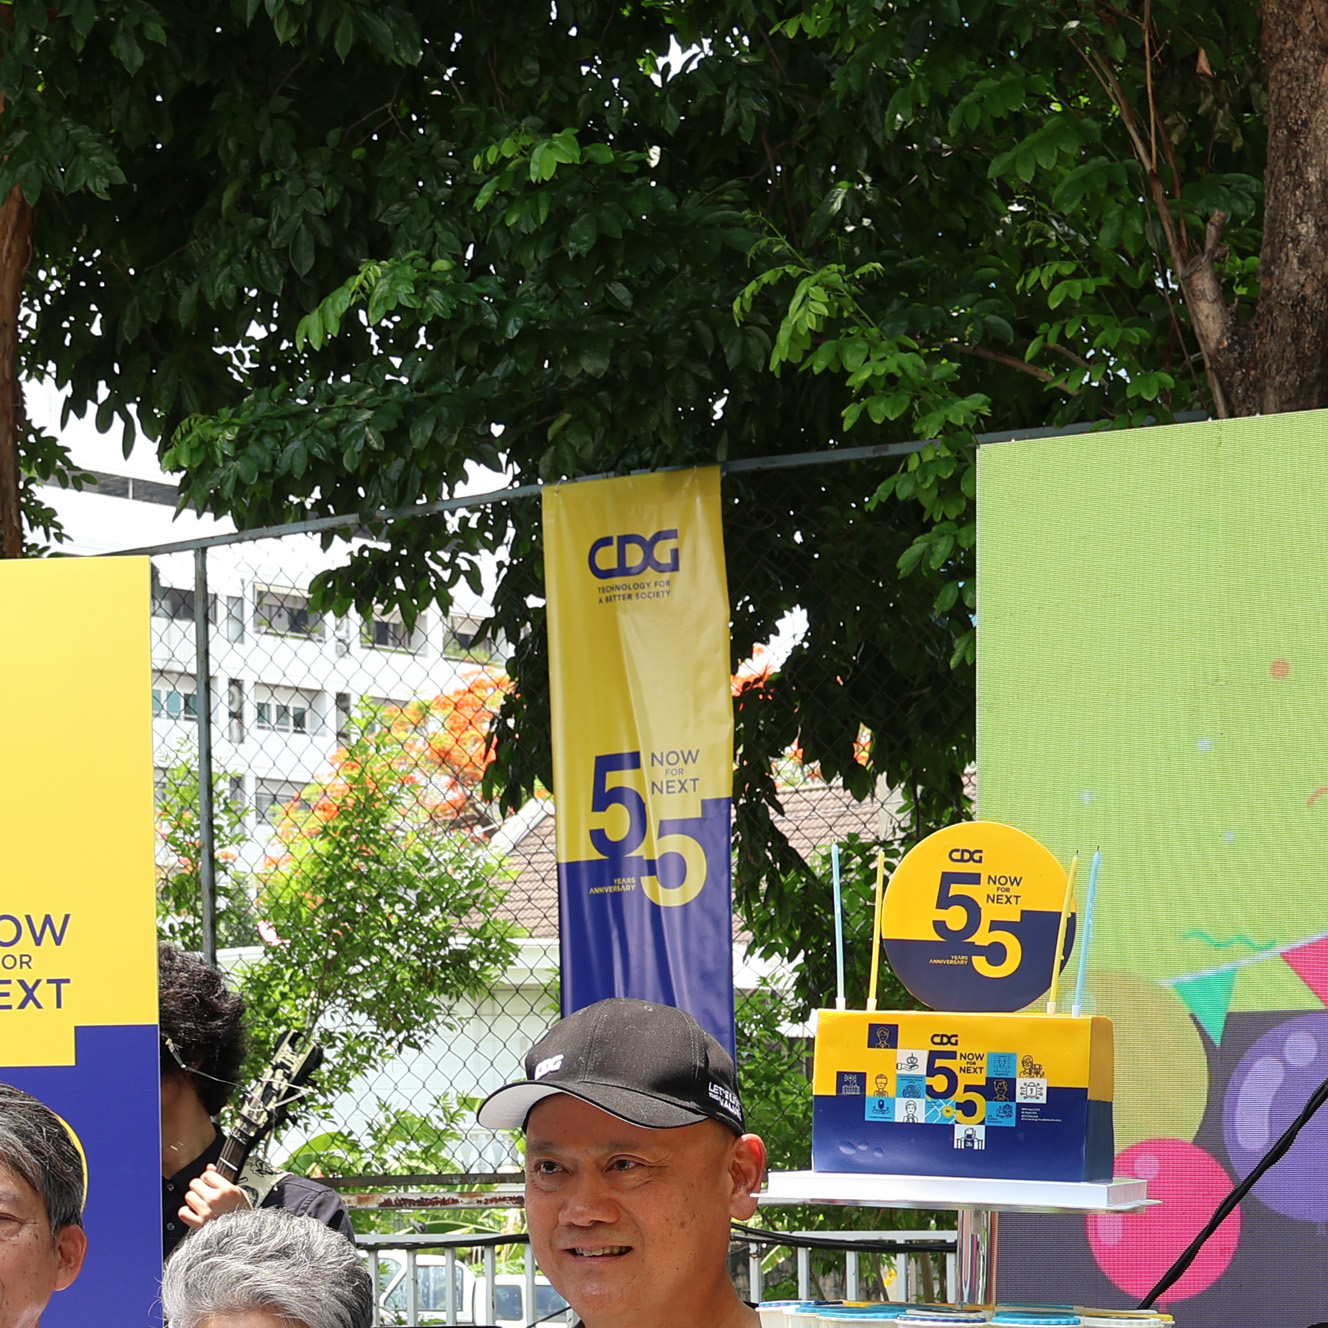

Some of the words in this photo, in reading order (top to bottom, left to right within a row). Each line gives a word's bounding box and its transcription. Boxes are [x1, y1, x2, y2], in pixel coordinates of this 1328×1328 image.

[588, 528, 679, 579] CDG
[598, 581, 651, 595] TECHNOLOGY
[654, 579, 671, 589] FOR
[605, 594, 632, 603] BETTER
[635, 590, 671, 600] SOCIETY
[651, 749, 700, 767] NOW
[665, 768, 684, 776] FOR
[651, 778, 700, 795] NEXT
[948, 848, 983, 863] CDG
[614, 877, 636, 885] YEARS
[987, 875, 1023, 887] NOW
[589, 884, 636, 895] ANNIVERSARY
[986, 894, 1022, 905] NEXT
[930, 1034, 959, 1046] CDG
[959, 1053, 985, 1061] NOW
[959, 1066, 985, 1074] NEXT
